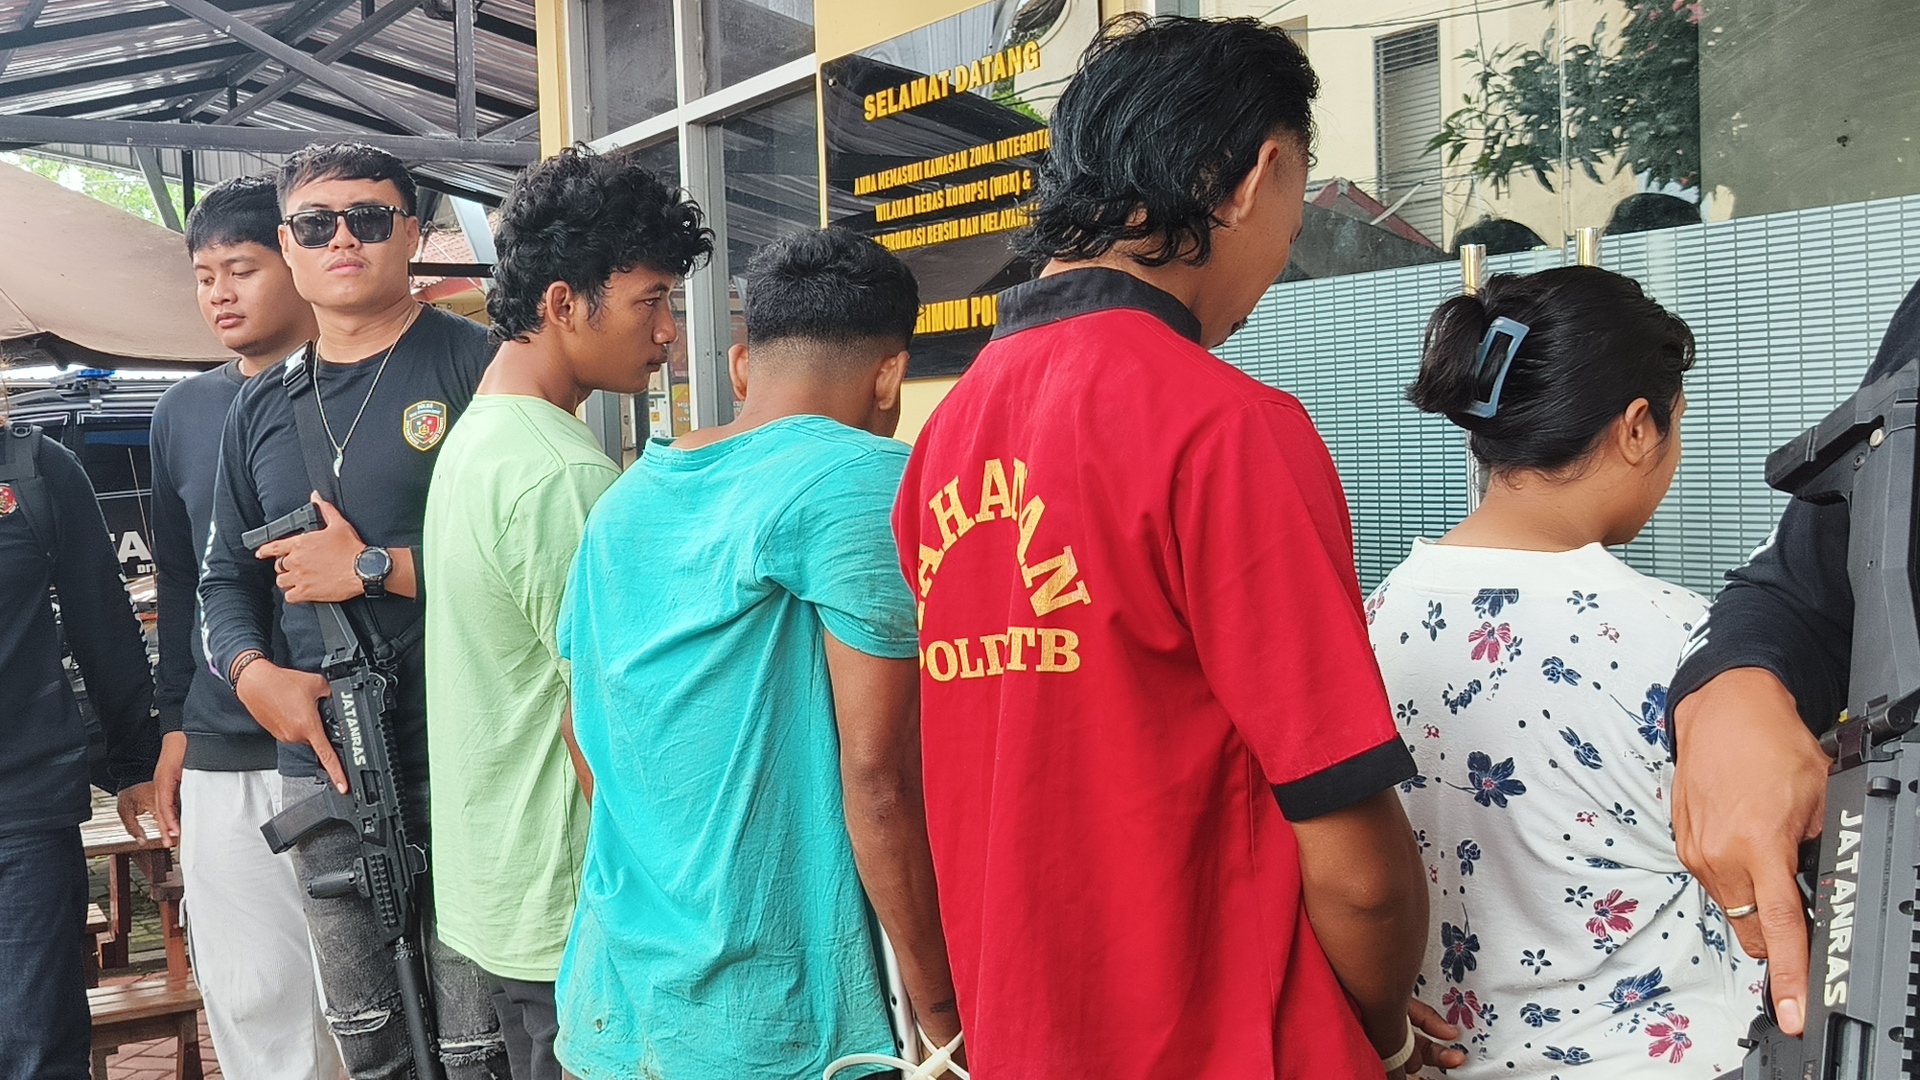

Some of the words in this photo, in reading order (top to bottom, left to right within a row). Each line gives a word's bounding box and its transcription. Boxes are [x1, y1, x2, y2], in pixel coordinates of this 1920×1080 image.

[863, 70, 951, 122] SELAMAT
[955, 40, 1041, 94] DATANG
[854, 174, 877, 196] ANDA
[877, 161, 923, 191] MEMASUKI
[924, 150, 968, 179] KAWASAN
[969, 142, 995, 168] ZONA
[996, 128, 1051, 161] INTEGRITA
[875, 196, 914, 223] WILAYAH
[914, 189, 945, 214] BEBAS
[945, 179, 988, 207] KORUPSI
[989, 169, 1020, 201] (WBK)
[1022, 169, 1031, 191] &
[926, 219, 959, 244] BERSIH
[960, 215, 979, 238] DAN
[340, 691, 366, 766] JATANRAS
[1824, 809, 1864, 1007] JATANRAS
